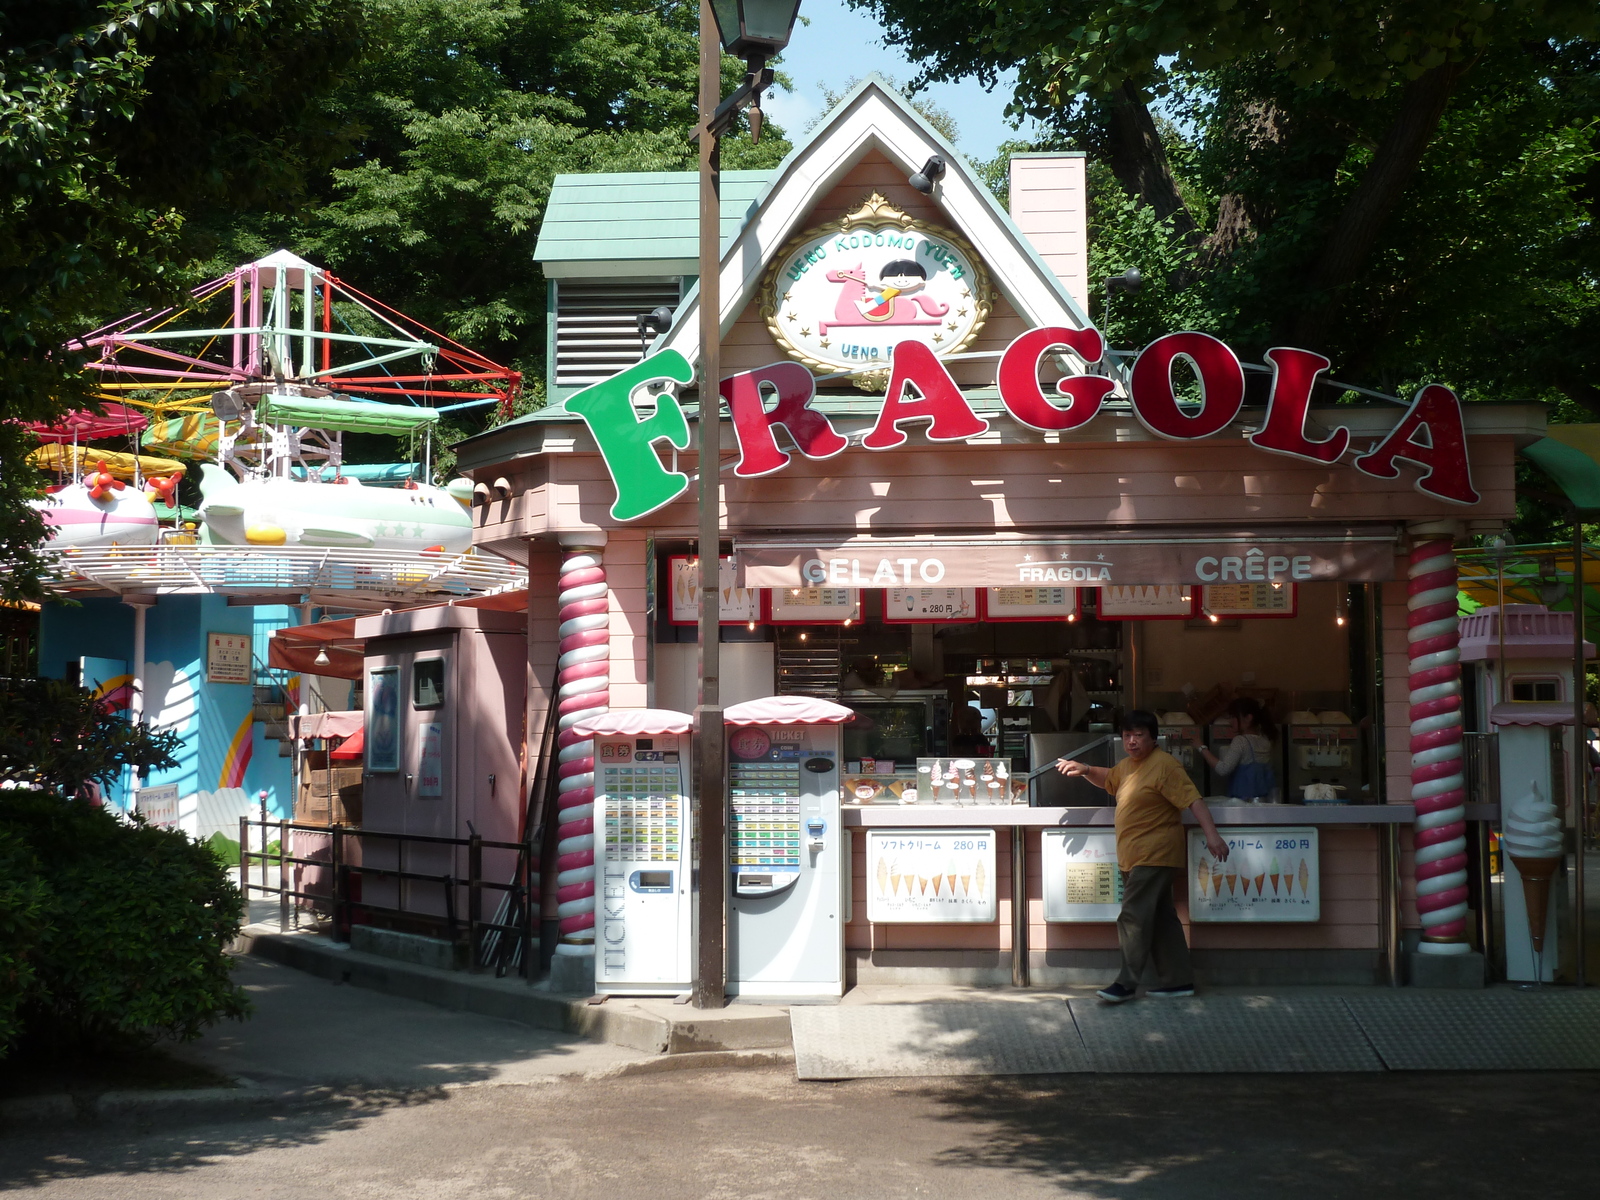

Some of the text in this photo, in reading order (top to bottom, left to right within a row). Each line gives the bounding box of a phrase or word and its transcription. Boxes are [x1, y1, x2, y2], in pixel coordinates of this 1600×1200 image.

[786, 234, 967, 282] UENO KODOMO YŪEN
[841, 343, 878, 357] UENO
[562, 327, 1481, 522] FRAGOLA
[803, 558, 945, 583] GELATO
[1019, 566, 1112, 582] FRAGOLA
[1195, 547, 1312, 582] CRÊPE
[771, 730, 806, 740] TICKET
[602, 744, 630, 757] 食券
[881, 840, 941, 850] ソフトクリーム
[604, 866, 625, 976] TICKET
